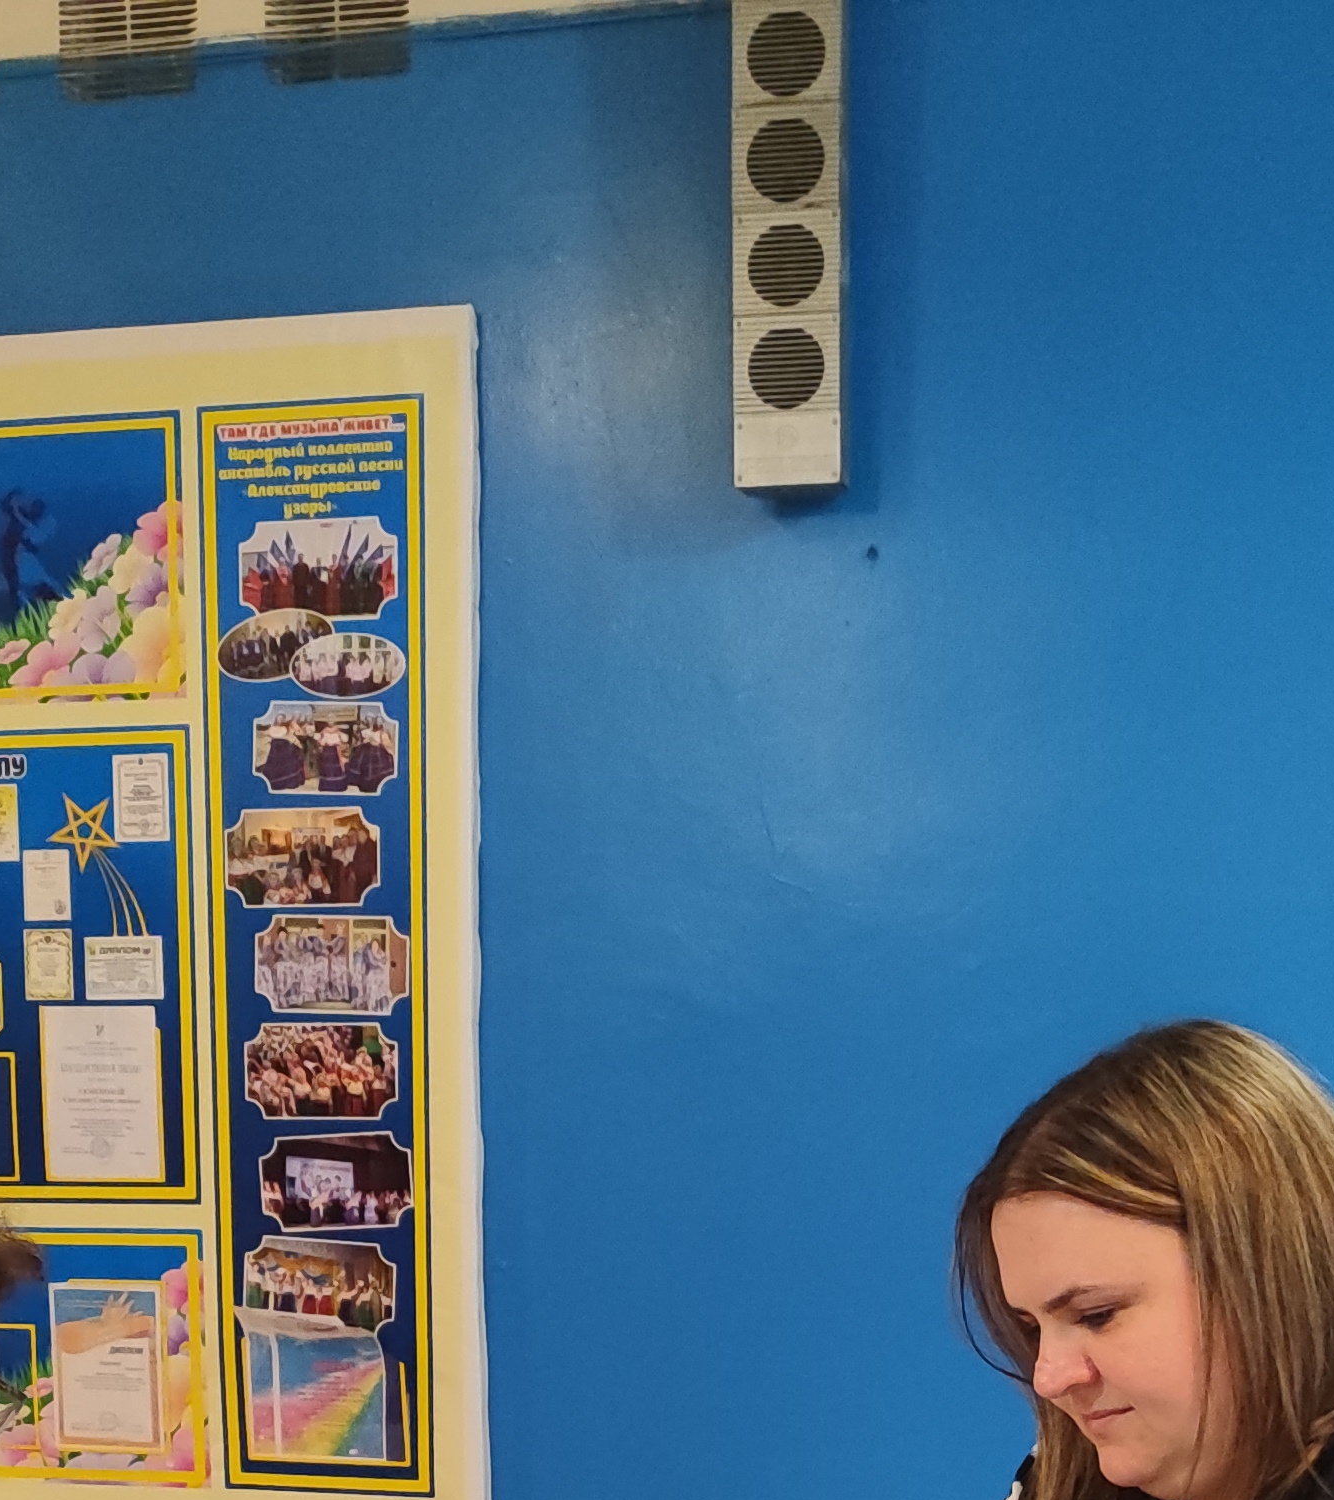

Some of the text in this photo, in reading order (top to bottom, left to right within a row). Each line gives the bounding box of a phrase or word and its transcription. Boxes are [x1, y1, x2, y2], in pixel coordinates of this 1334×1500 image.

[220, 427, 248, 439] ТАМ
[251, 424, 276, 438] ГДЕ
[280, 421, 339, 435] МУЗЫКА
[228, 440, 393, 464] Народный коллектив
[219, 459, 404, 481] ансамбль русской песни
